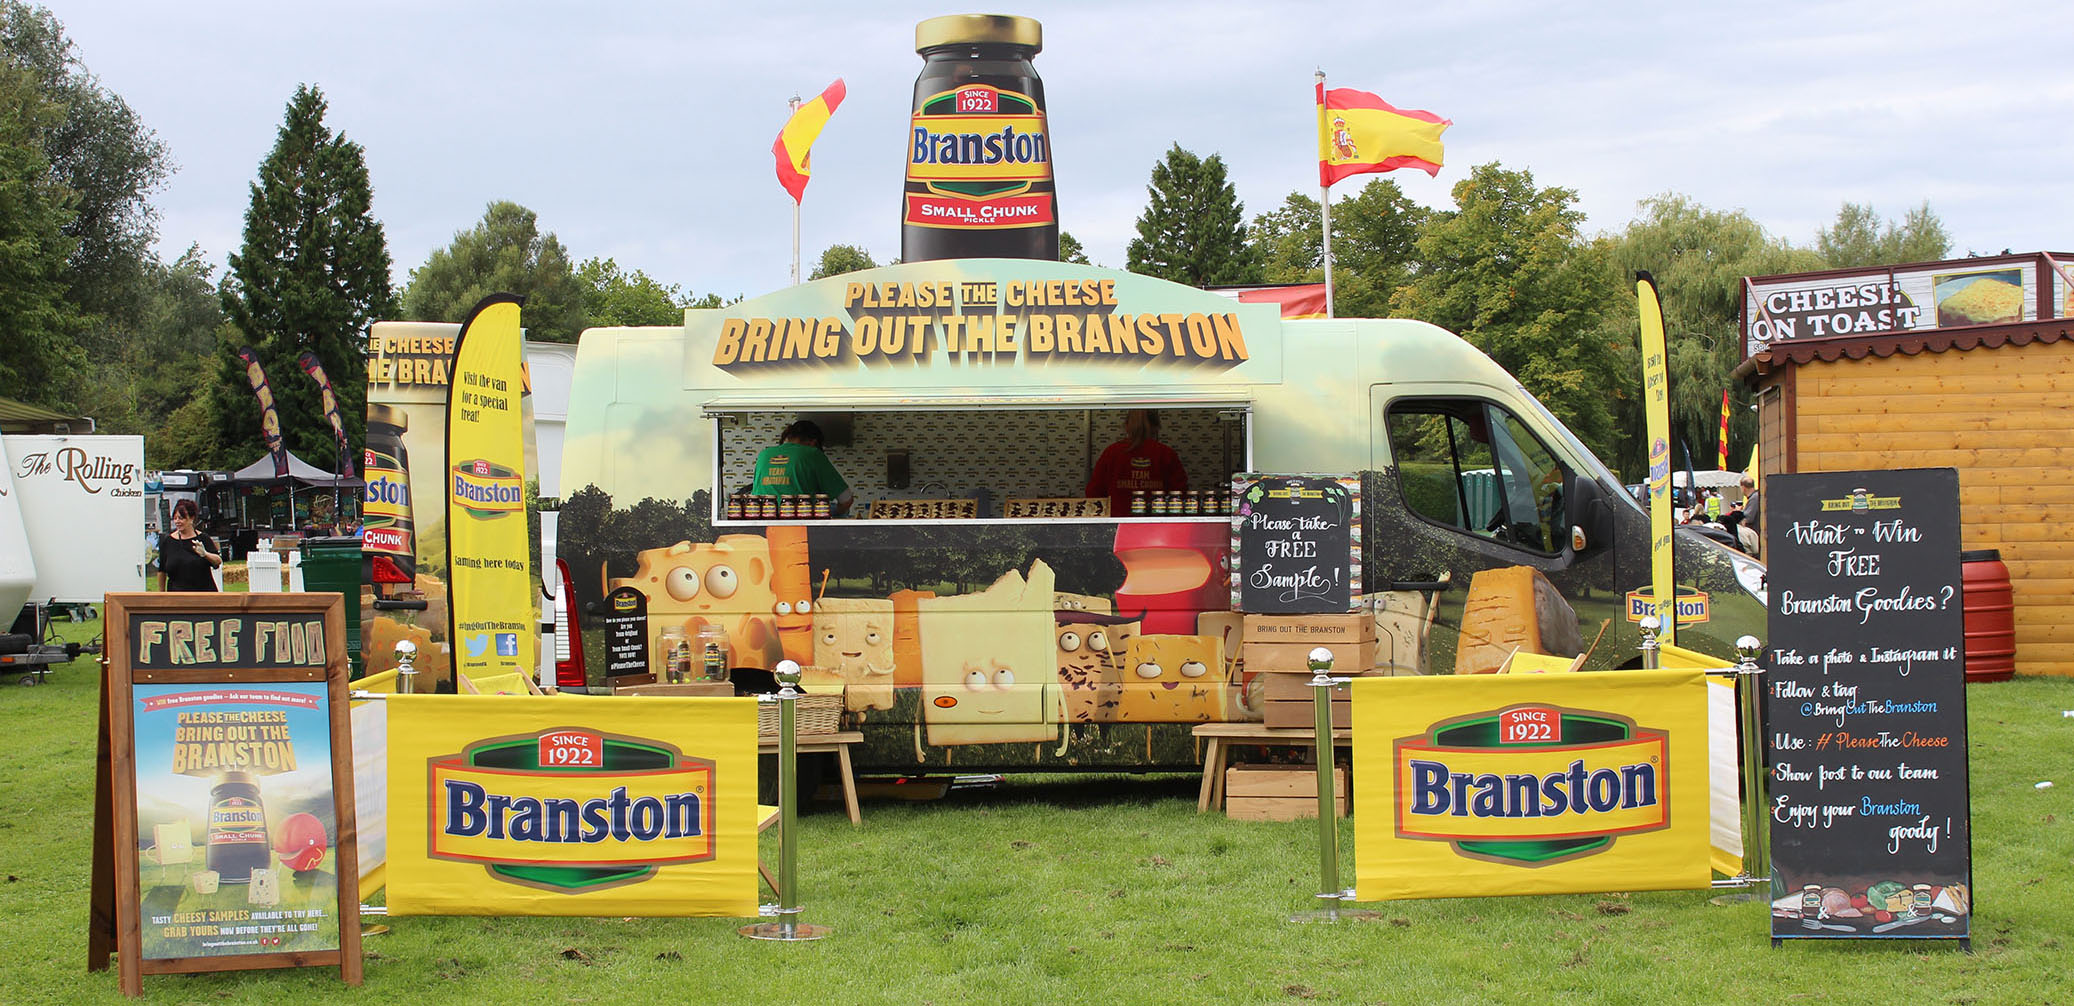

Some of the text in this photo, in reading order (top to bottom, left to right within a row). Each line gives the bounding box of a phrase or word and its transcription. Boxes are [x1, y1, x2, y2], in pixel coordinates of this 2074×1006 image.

[964, 90, 989, 99] SINCE
[961, 99, 992, 111] 1922
[911, 125, 1048, 165] Branston
[921, 204, 1038, 218] SMALL CHUNK
[845, 279, 1118, 308] PLEASE THE CHEESE
[1766, 281, 1902, 314] CHEESE
[1752, 306, 1921, 342] ON TOAST
[385, 337, 454, 354] CHEESE
[712, 312, 1249, 366] BRING OUT THE BRANSTON
[463, 371, 507, 392] Visit the van
[462, 390, 508, 411] for a special
[17, 447, 135, 494] The Rolling
[475, 466, 488, 474] 1922
[110, 488, 143, 498] Chicken
[455, 475, 522, 503] Branston
[1251, 512, 1337, 530] Please take
[365, 531, 402, 545] CHUNK
[1292, 532, 1302, 540] a
[1786, 520, 1850, 545] Want
[1872, 520, 1922, 543] Win
[1265, 539, 1317, 558] FREE
[484, 558, 503, 568] here
[505, 559, 524, 571] today
[1827, 547, 1880, 577] FREE
[1250, 564, 1331, 602] Sample
[1631, 598, 1705, 617] Braton
[1781, 590, 1852, 615] Branston
[1855, 585, 1936, 625] Goodies
[1257, 625, 1277, 633] BRING
[140, 618, 242, 665] FREE
[1774, 648, 1804, 665] Take
[1808, 655, 1819, 664] a
[1824, 648, 1853, 674] photo
[1859, 655, 1867, 663] &
[1870, 647, 1939, 676] Instagram
[1943, 646, 1957, 661] it
[1775, 681, 1815, 699] Follow
[1822, 688, 1831, 697] &
[1833, 681, 1858, 706] tag
[178, 711, 288, 724] PLEASE THE CHEESE
[1511, 712, 1547, 723] SINCE
[176, 726, 291, 742] BRING OUT THE
[552, 736, 588, 747] SINCE
[1508, 724, 1551, 741] 1922
[1775, 733, 1807, 750] Use
[173, 742, 297, 772] BRANSTON
[548, 748, 593, 764] 1922
[1776, 763, 1813, 782] Show
[1819, 764, 1847, 790] post
[1851, 764, 1865, 780] to
[1897, 763, 1939, 780] team
[1410, 759, 1657, 818] Branston
[213, 810, 263, 823] Branston
[444, 779, 702, 843] Branston
[1774, 795, 1818, 828] Enjoy
[1823, 805, 1856, 828] your
[1860, 796, 1920, 816] Branston
[1887, 815, 1940, 854] goody
[152, 916, 171, 924] TASTY
[173, 912, 207, 924] CHEESY
[209, 910, 250, 922] SAMPLES
[251, 912, 282, 920] AVAILABLE
[163, 926, 187, 938] GRAB
[190, 925, 219, 937] YOURS
[220, 926, 234, 935] NOW
[236, 926, 258, 934] BEFORE
[287, 924, 298, 932] ALL
